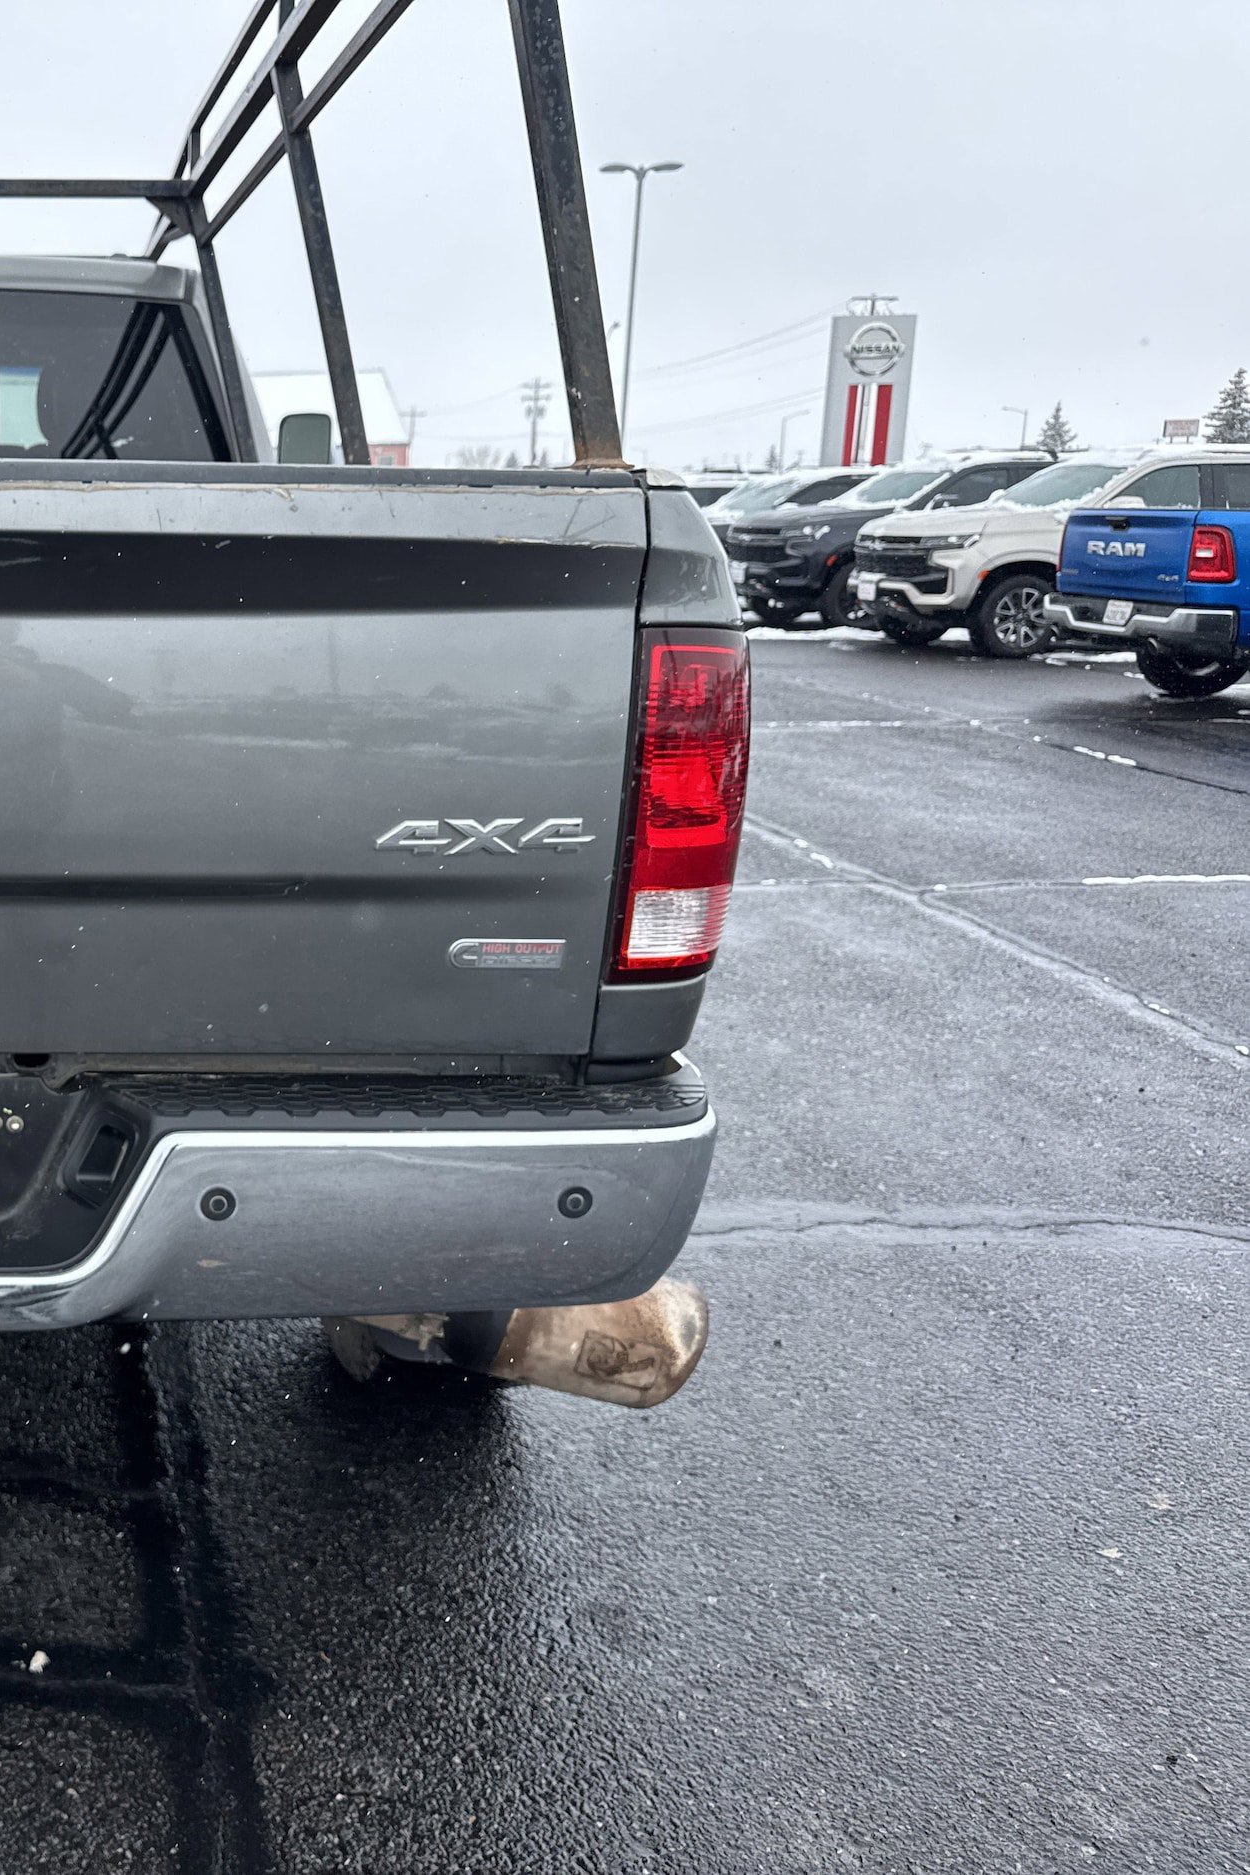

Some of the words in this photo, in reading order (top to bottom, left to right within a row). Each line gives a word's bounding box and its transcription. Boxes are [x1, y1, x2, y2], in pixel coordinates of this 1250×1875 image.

[850, 344, 899, 354] NISSAN
[1087, 540, 1146, 557] RAM
[482, 943, 510, 954] HIGH
[515, 943, 561, 954] OUTPUT
